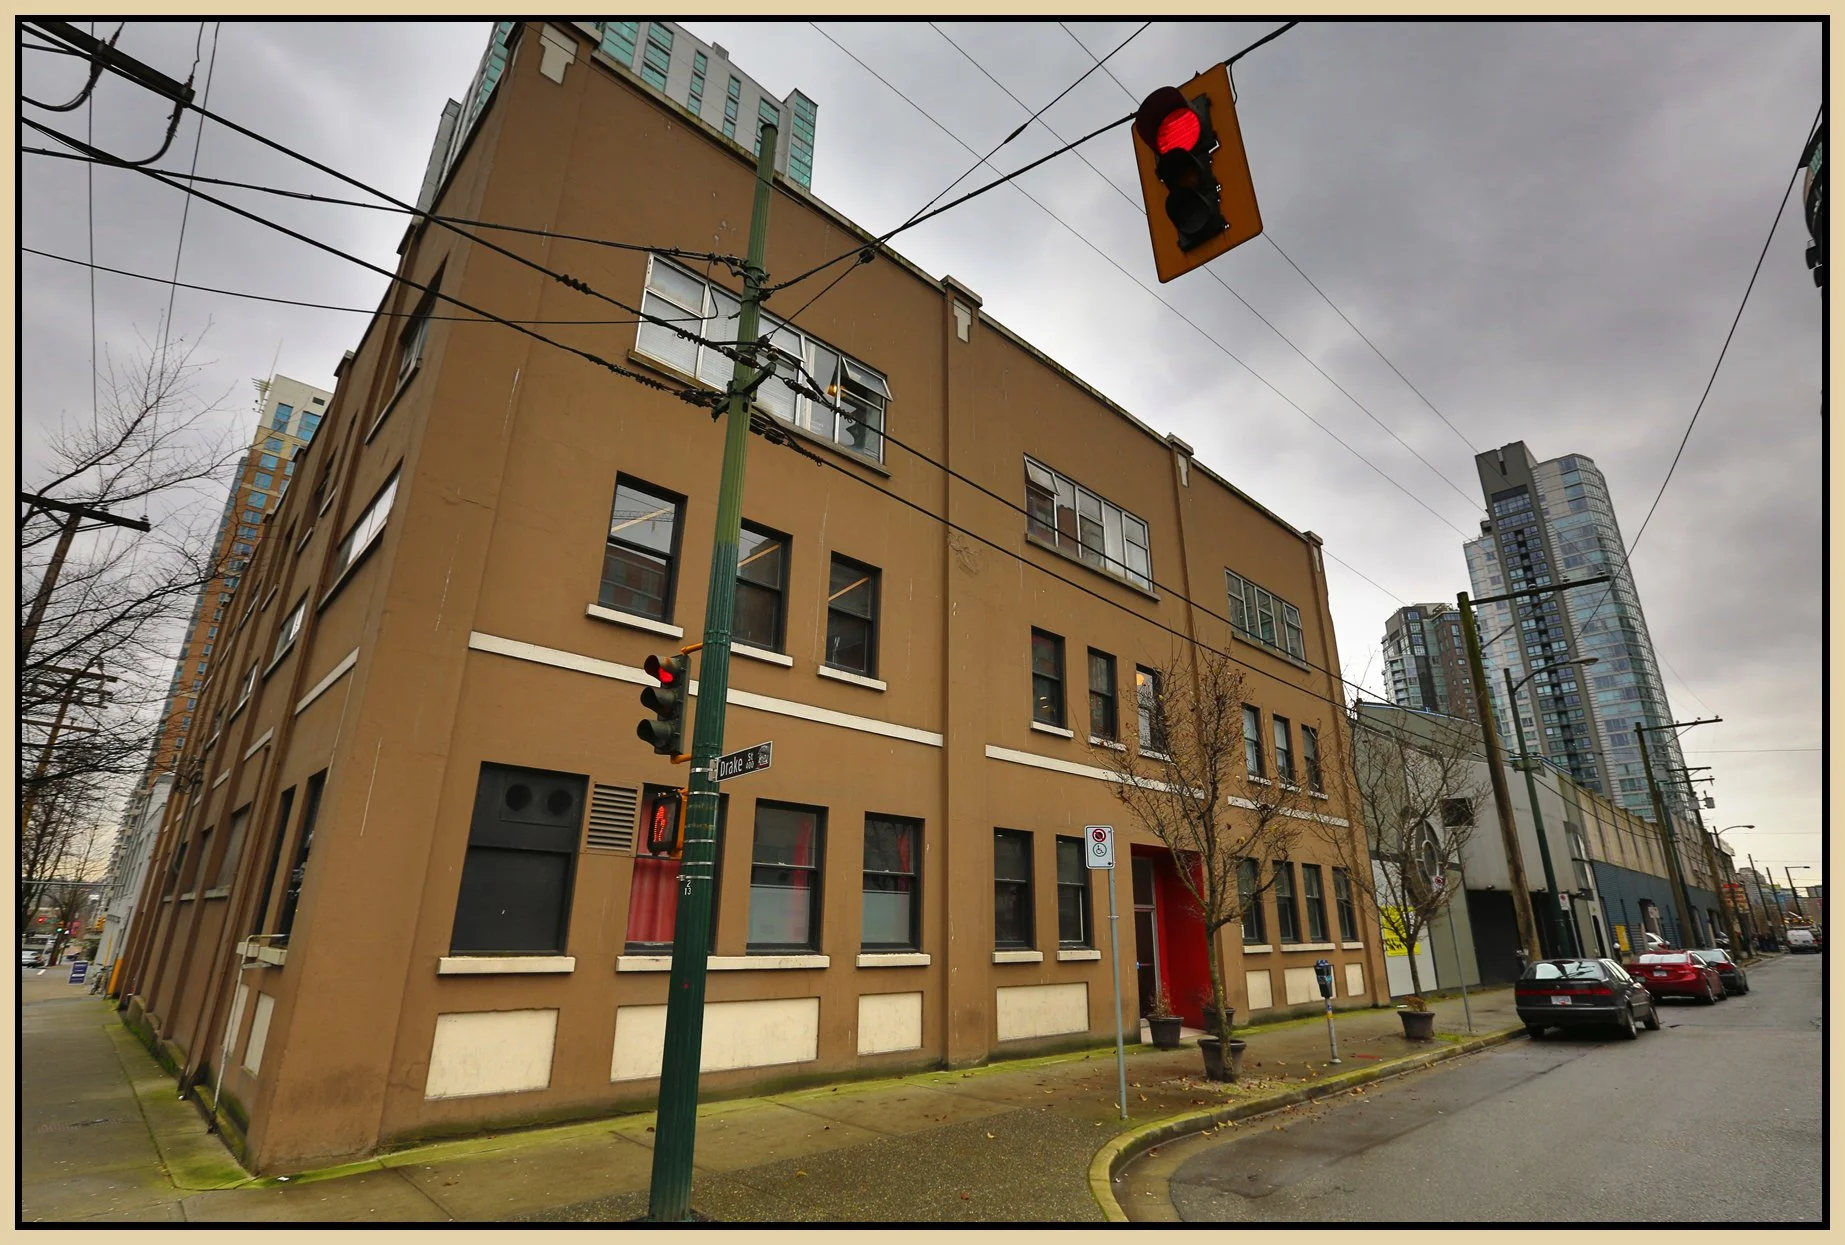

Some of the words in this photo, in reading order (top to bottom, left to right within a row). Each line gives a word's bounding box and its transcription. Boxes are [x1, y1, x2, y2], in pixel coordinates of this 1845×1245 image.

[720, 757, 743, 777] Drake
[747, 752, 754, 762] St
[745, 761, 755, 770] 400
[686, 880, 692, 888] 2
[684, 887, 692, 896] 13
